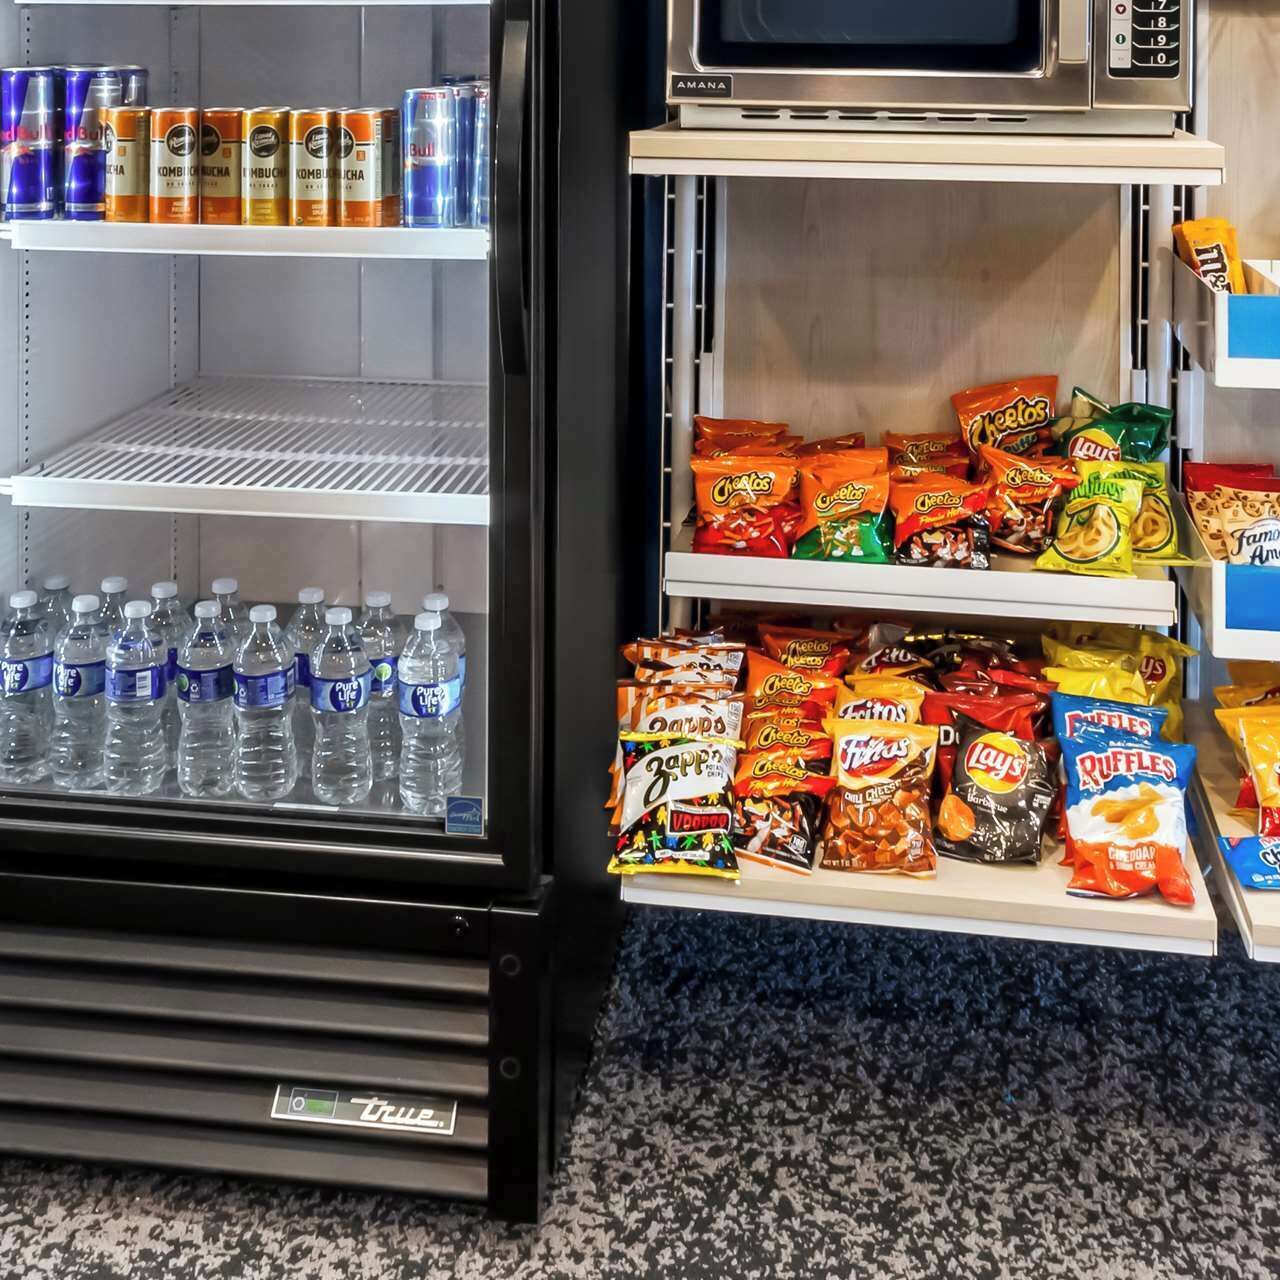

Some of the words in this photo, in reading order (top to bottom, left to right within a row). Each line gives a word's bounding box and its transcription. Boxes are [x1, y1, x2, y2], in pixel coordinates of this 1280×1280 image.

[1158, 0, 1167, 10] 7
[1158, 17, 1167, 28] 8
[1157, 35, 1166, 46] 9
[1157, 52, 1166, 64] 0
[676, 81, 726, 89] AMANA
[409, 143, 435, 157] Bull
[968, 396, 1050, 453] Cheetos
[1005, 468, 1055, 488] Cheetos
[712, 474, 772, 505] Cheetos
[814, 483, 867, 512] Cheetos
[914, 491, 964, 514] Cheetos
[335, 680, 358, 692] Pure
[416, 686, 442, 698] Pure
[764, 673, 813, 696] Cheetos
[338, 691, 357, 702] Life
[419, 696, 440, 708] Life
[839, 698, 907, 721] Fritos
[758, 724, 812, 749] Cheetos
[839, 734, 912, 770] Fritos
[968, 742, 1025, 778] Lay's
[752, 759, 808, 780] Cheetos
[1076, 748, 1177, 792] RUFFLES
[672, 813, 728, 831] VOODOO
